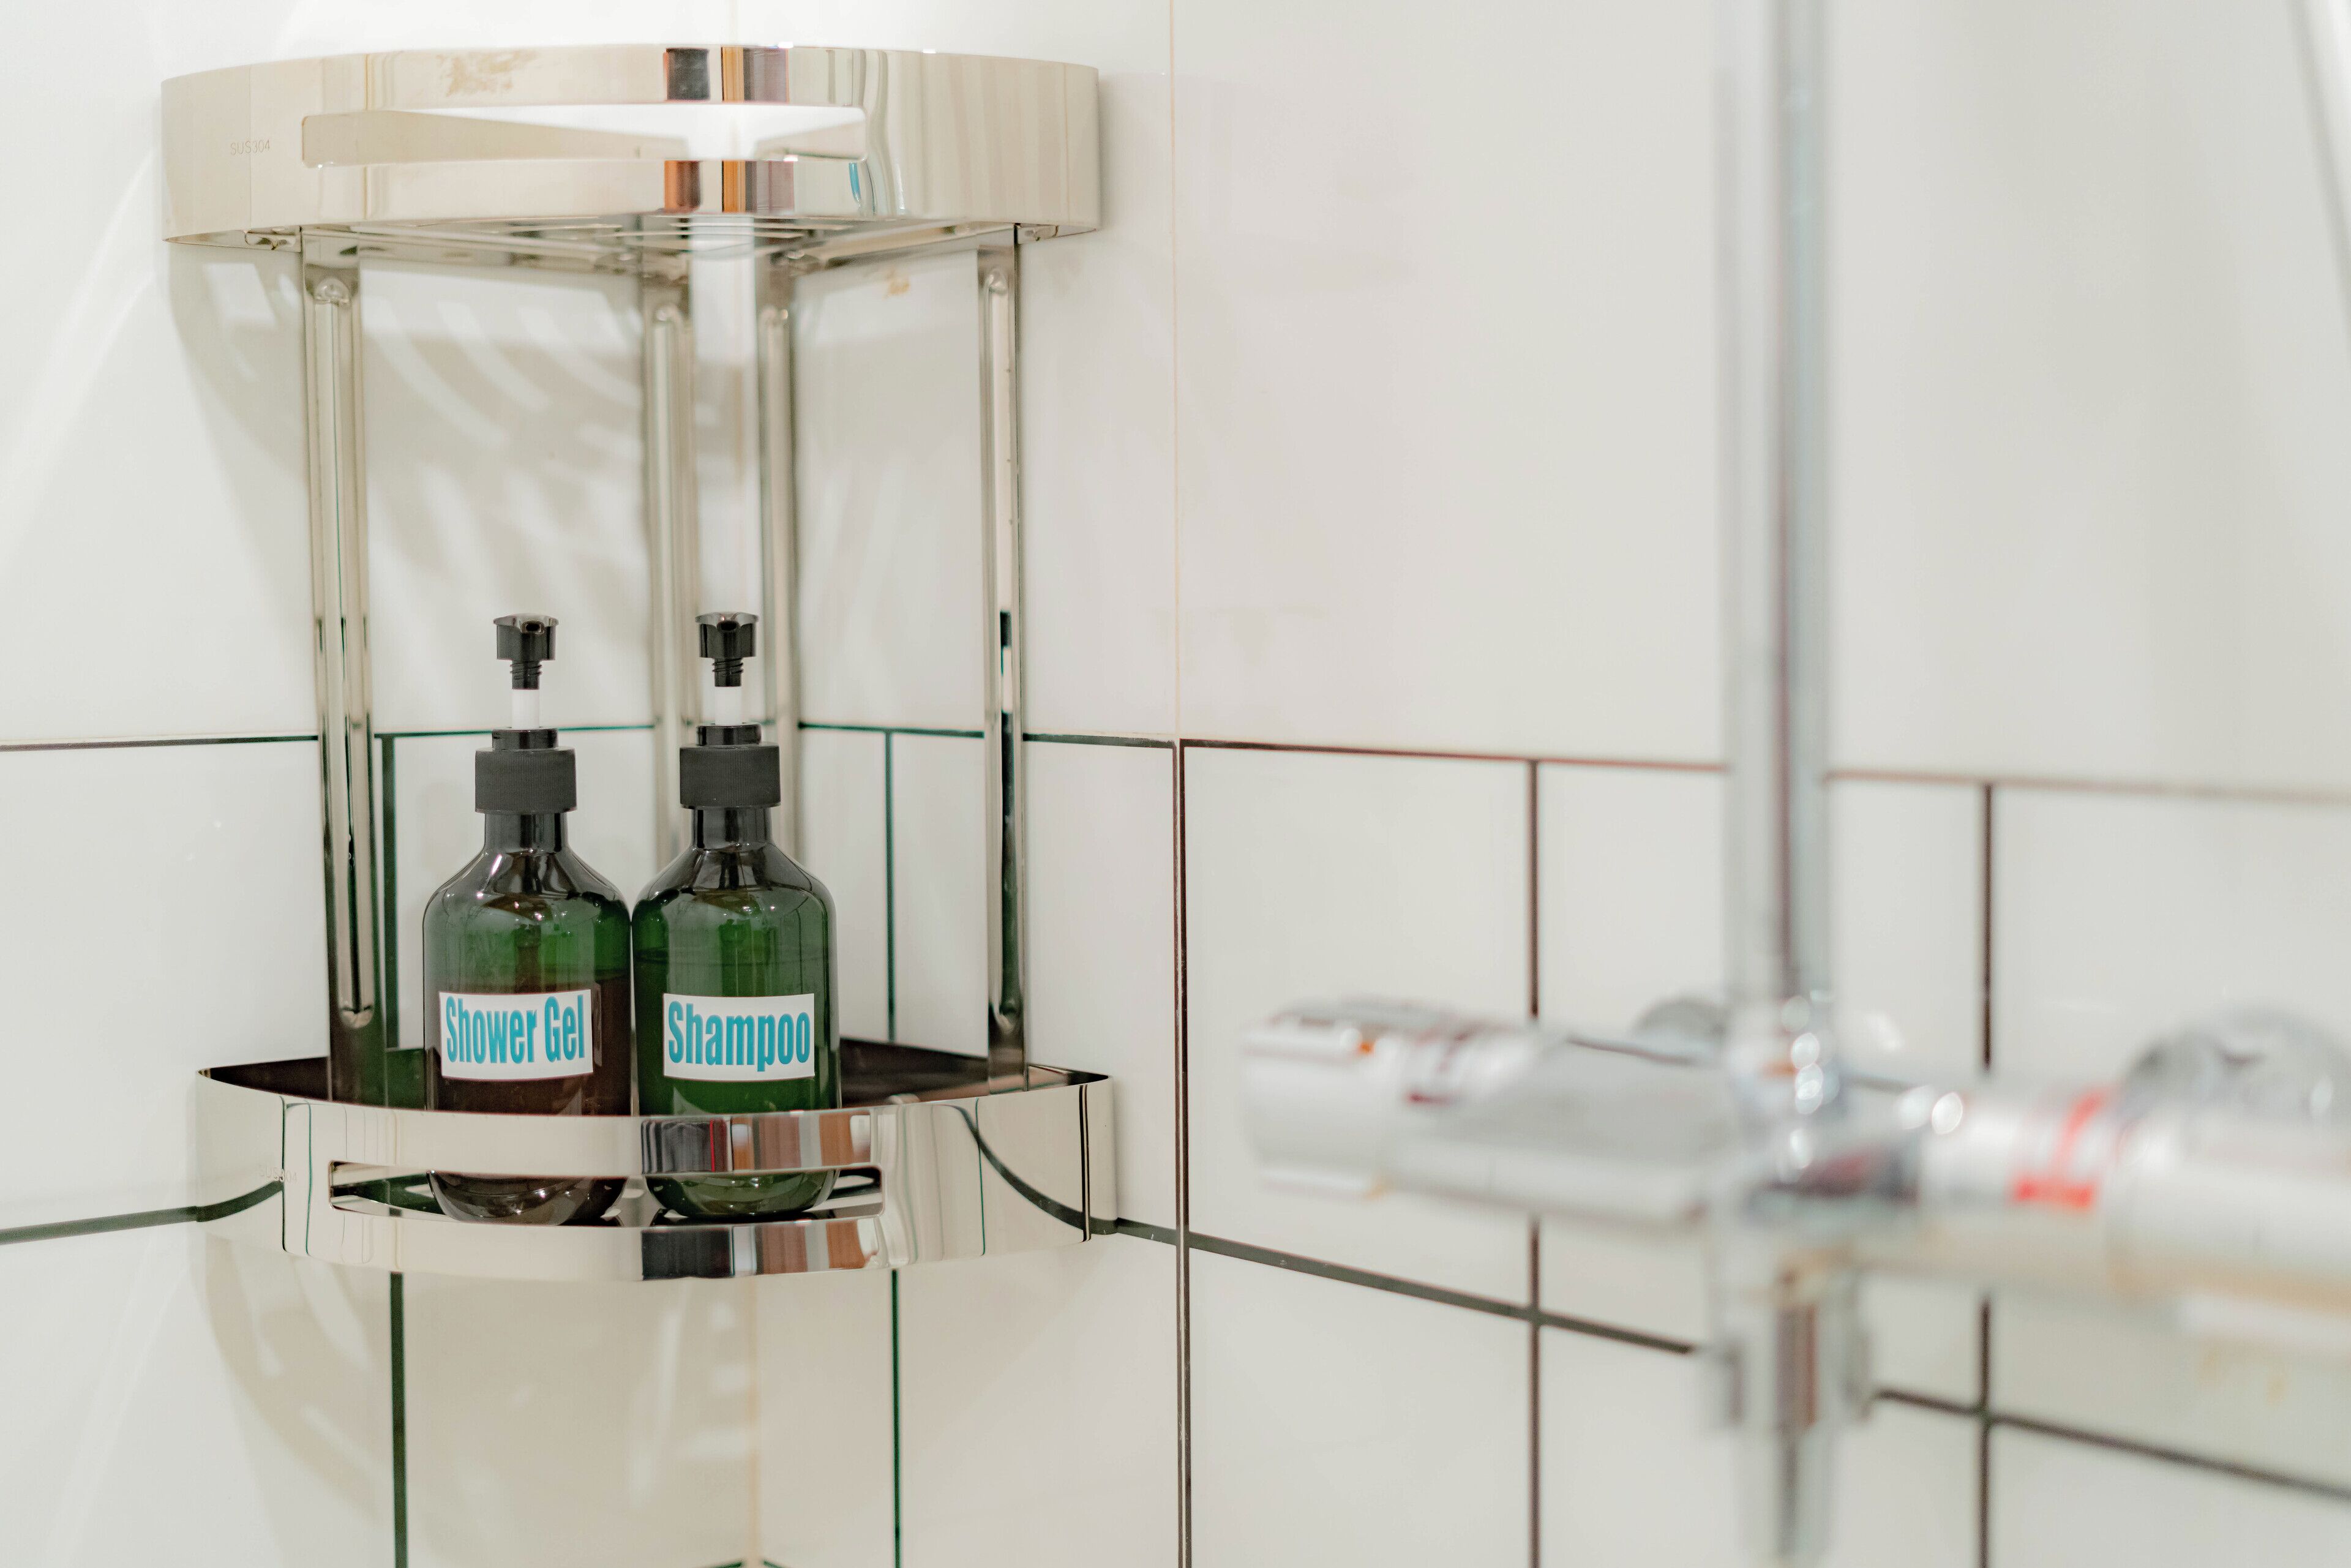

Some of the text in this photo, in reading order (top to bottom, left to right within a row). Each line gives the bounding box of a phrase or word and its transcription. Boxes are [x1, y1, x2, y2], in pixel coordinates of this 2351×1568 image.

[230, 140, 271, 156] SUS304
[446, 995, 586, 1064] Shower Gel
[667, 1000, 810, 1072] Shampoo
